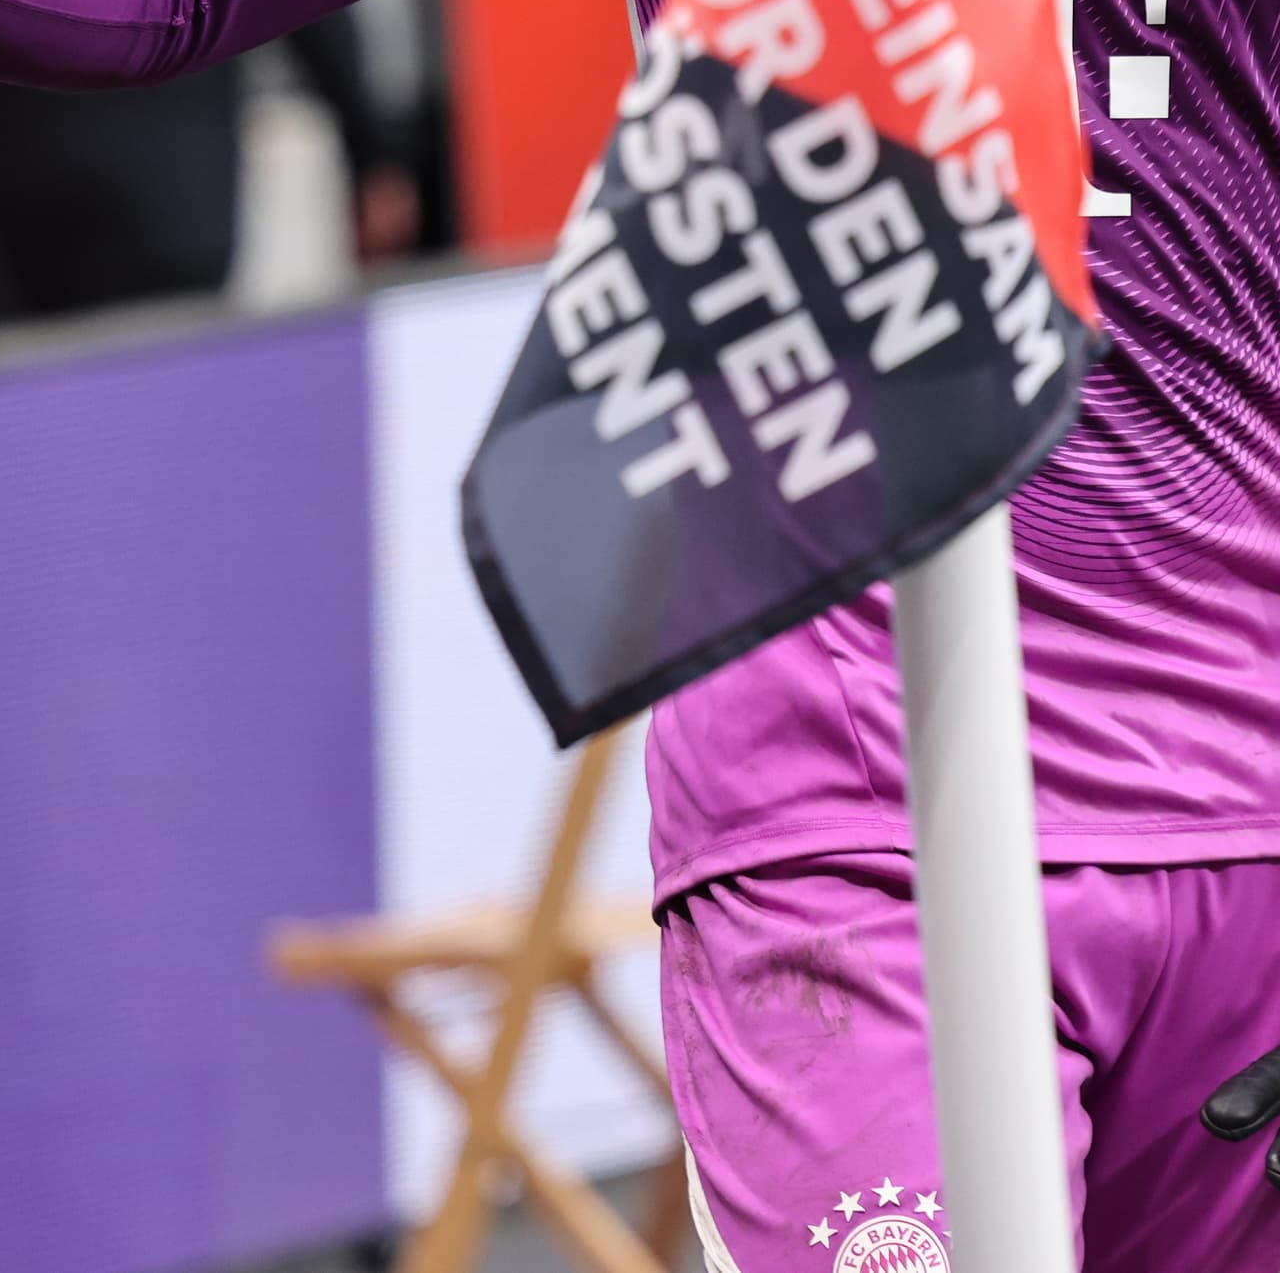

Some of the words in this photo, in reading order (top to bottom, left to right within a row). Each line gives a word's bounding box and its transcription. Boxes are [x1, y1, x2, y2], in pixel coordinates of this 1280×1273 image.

[766, 91, 963, 375] DEN
[843, 1242, 866, 1268] FC
[866, 1225, 942, 1268] BAYERN
